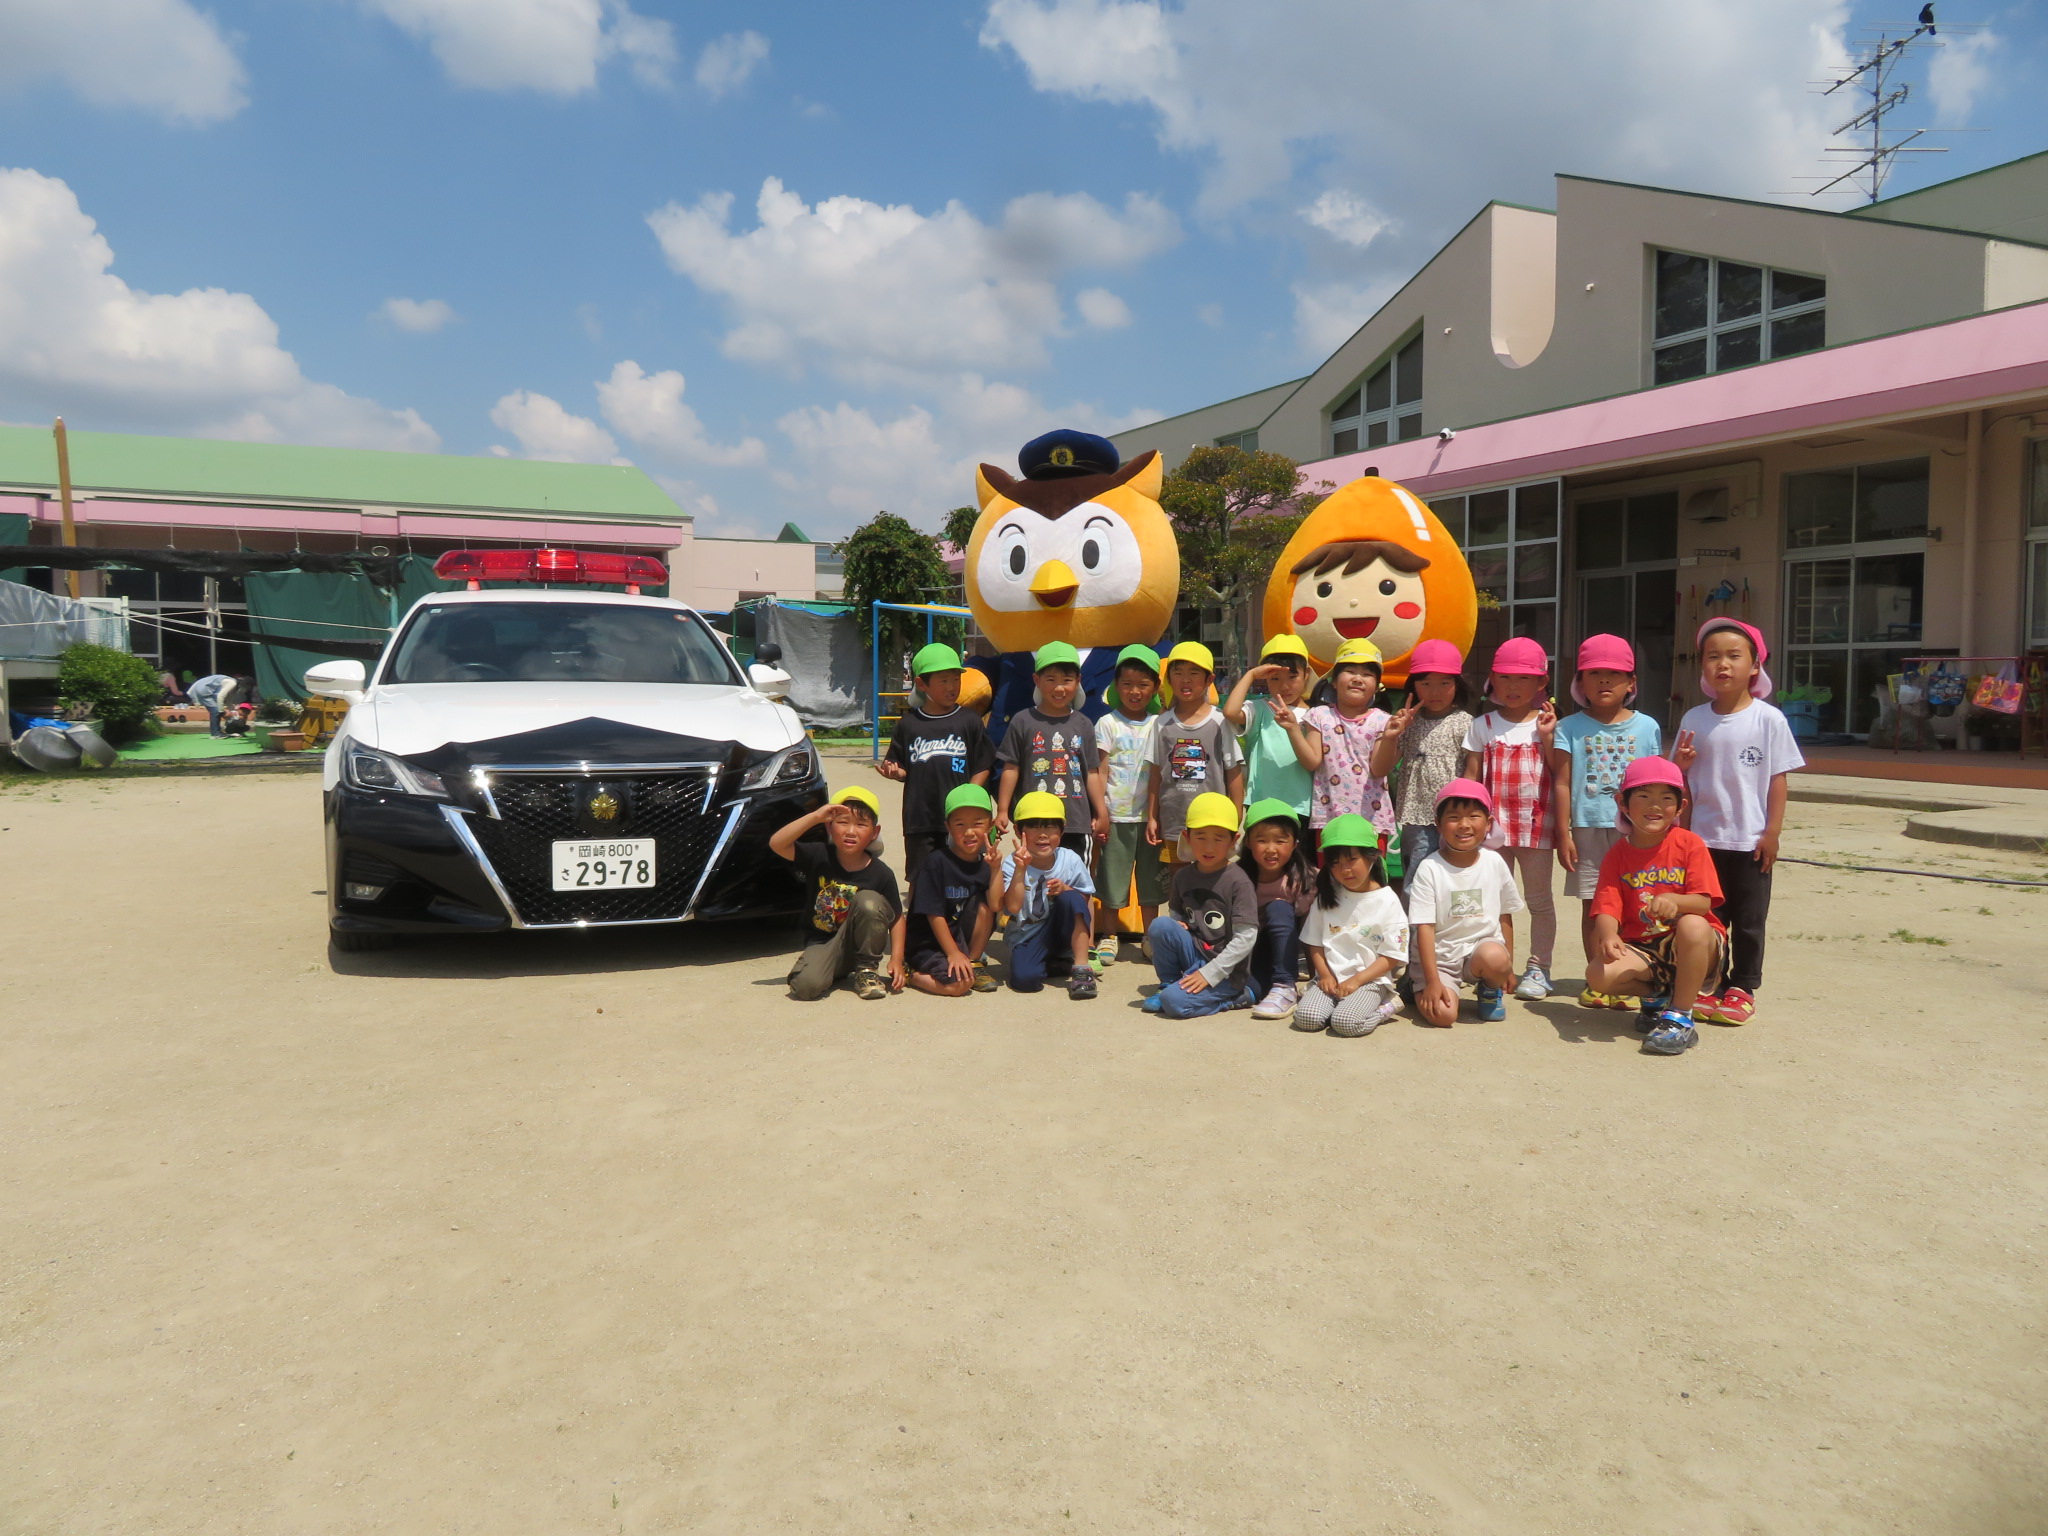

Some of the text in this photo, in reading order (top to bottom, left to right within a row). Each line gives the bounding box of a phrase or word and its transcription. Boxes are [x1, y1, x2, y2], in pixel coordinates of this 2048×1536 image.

[909, 733, 967, 763] Starship
[951, 757, 966, 774] 52
[561, 860, 650, 886] さ 29-78
